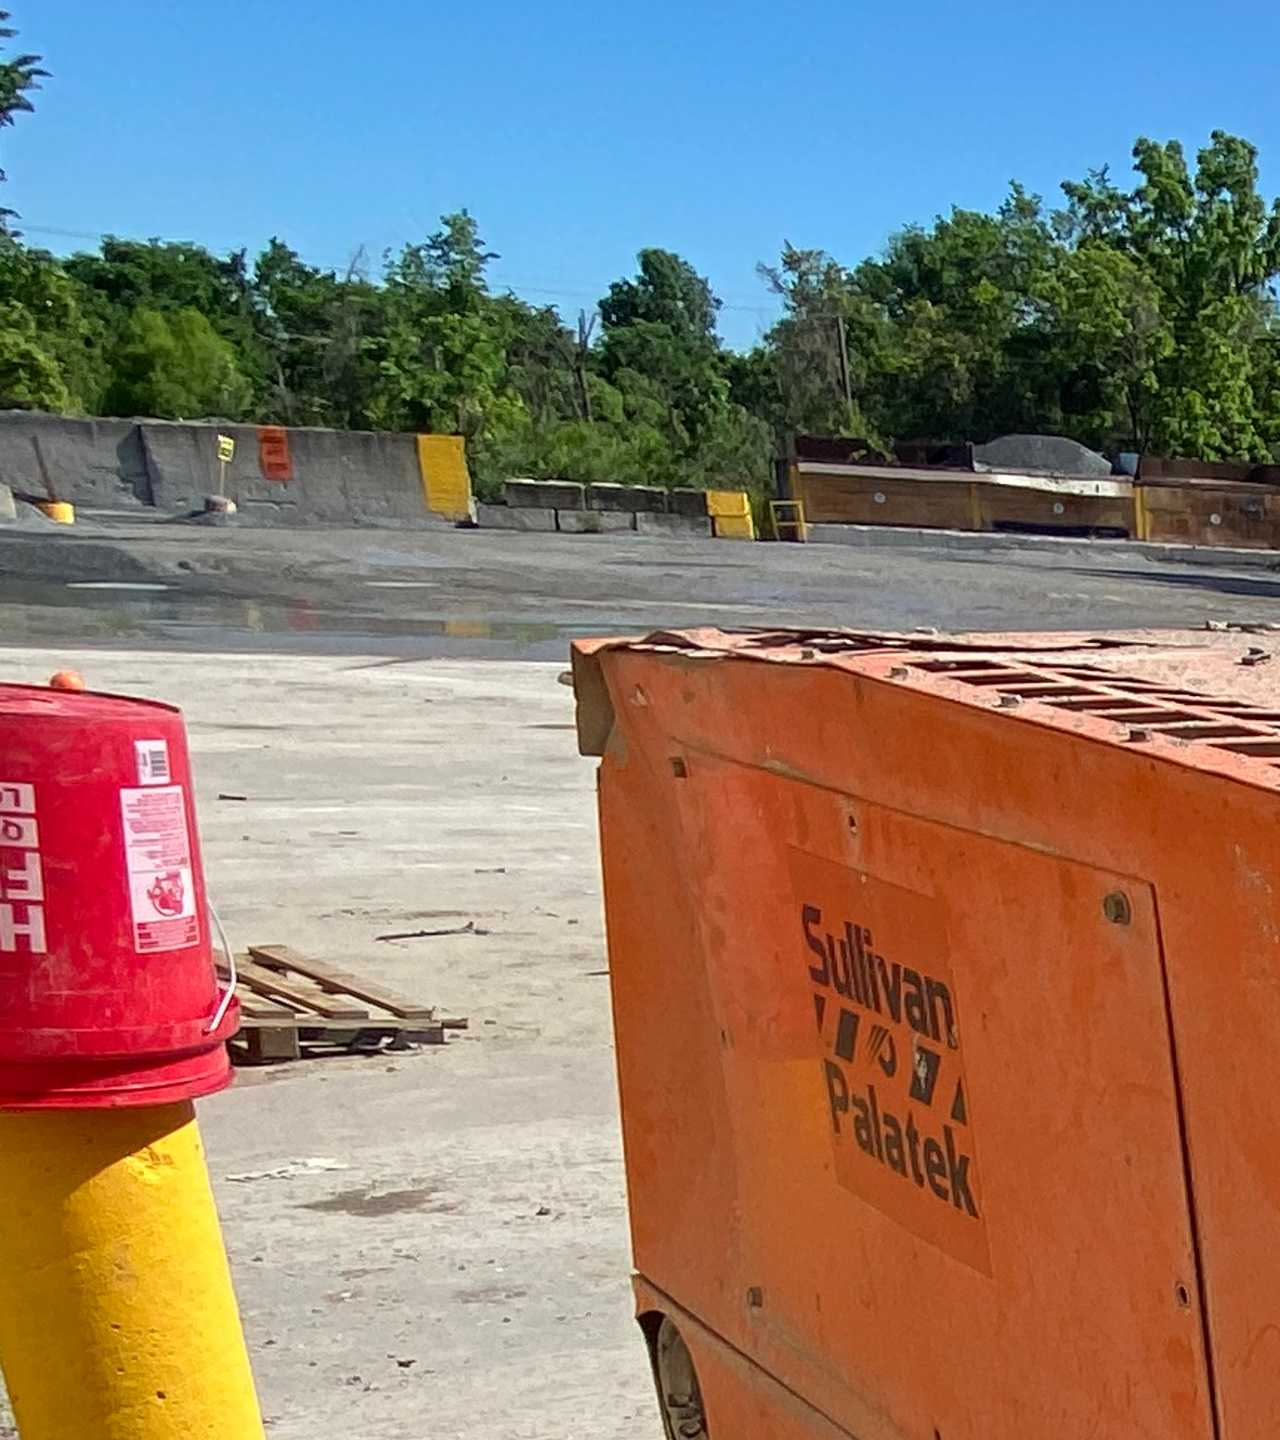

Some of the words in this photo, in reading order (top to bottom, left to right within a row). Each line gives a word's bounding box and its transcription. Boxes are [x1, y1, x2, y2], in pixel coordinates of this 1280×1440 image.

[0, 852, 44, 902] F
[802, 903, 958, 1050] Sullivan
[824, 1057, 980, 1219] Palatek
